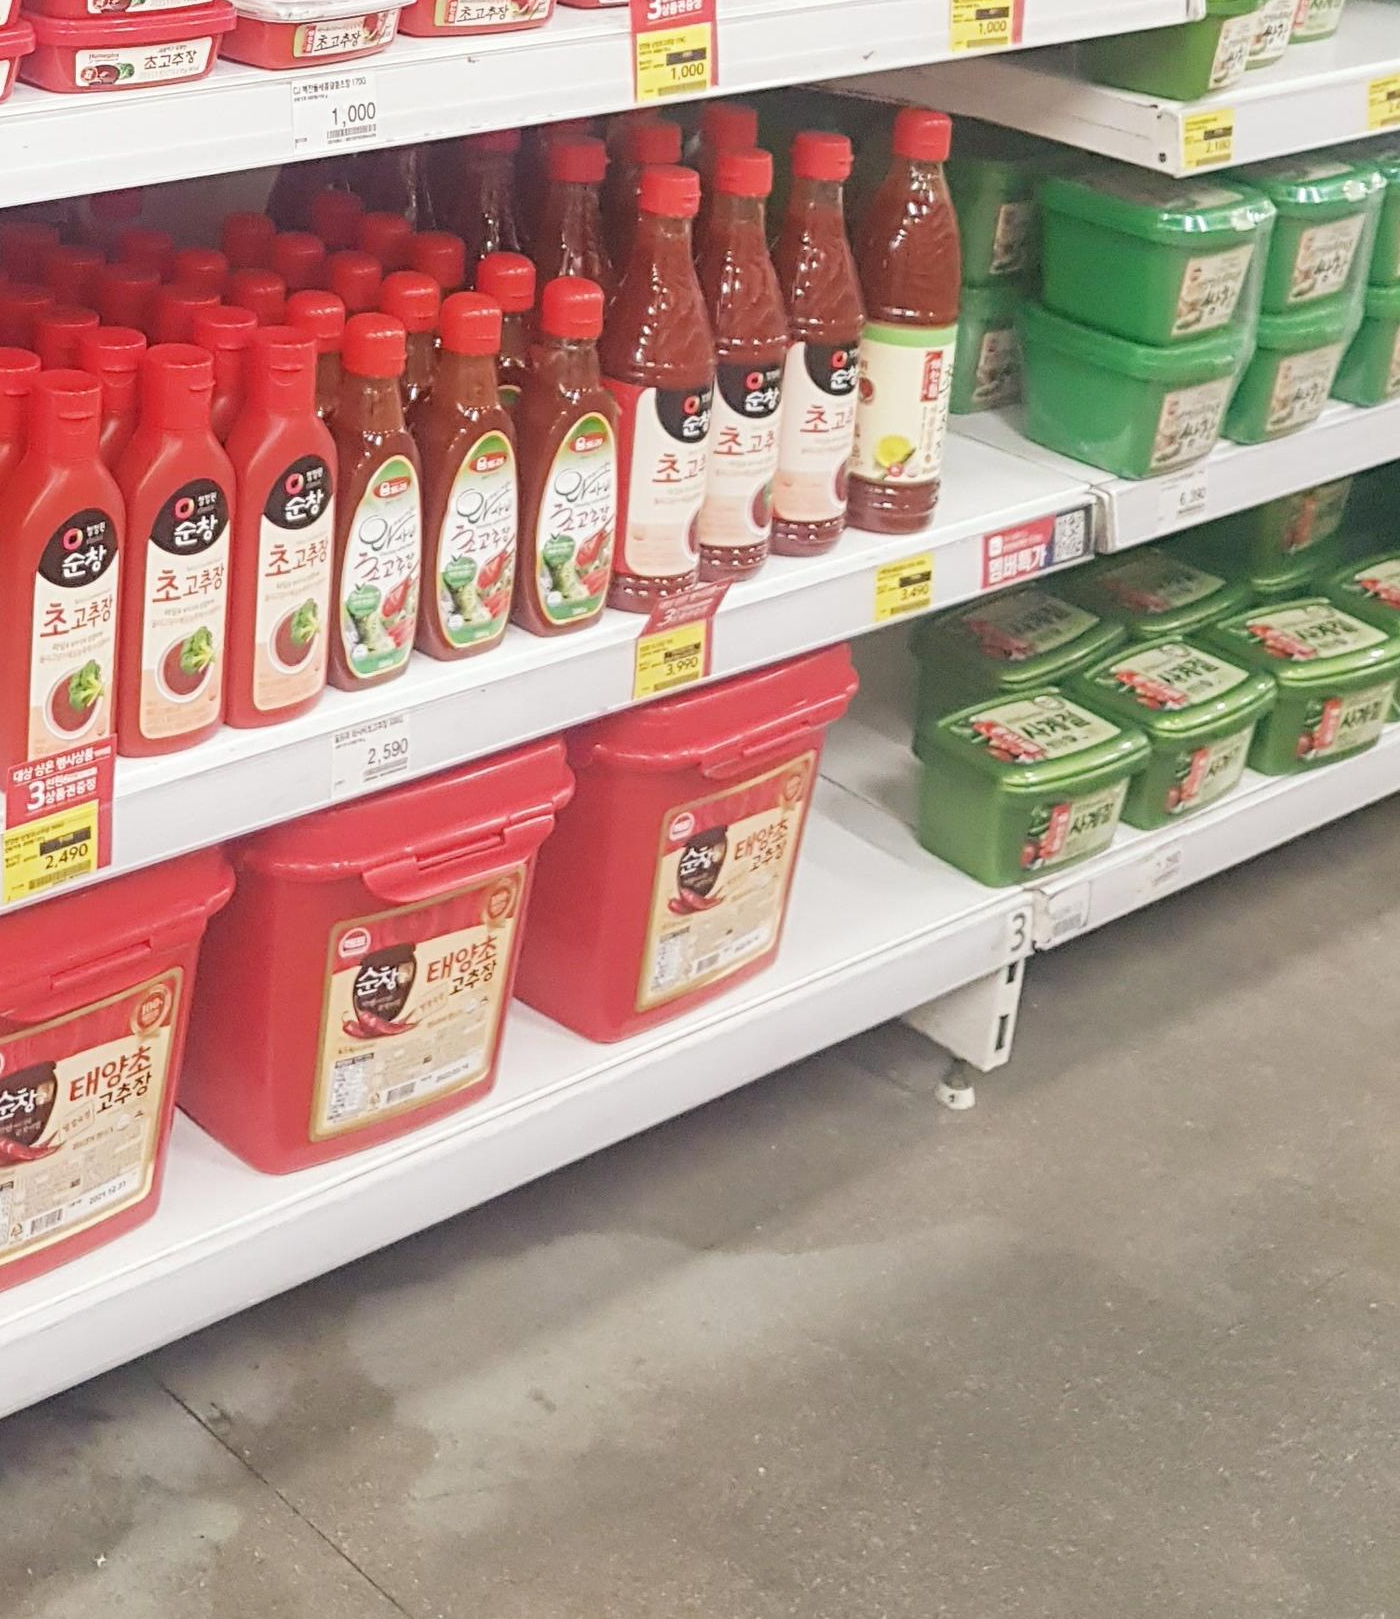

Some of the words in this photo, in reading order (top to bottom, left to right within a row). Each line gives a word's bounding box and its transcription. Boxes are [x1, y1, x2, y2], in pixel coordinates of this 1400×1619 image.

[457, 3, 510, 22] 초고추장
[977, 19, 1008, 35] 1,000
[314, 30, 363, 53] 초고추장
[671, 62, 704, 80] 1,000
[332, 102, 376, 127] 1,000
[744, 389, 781, 416] 순창
[988, 540, 1047, 577] 멤버특가
[900, 583, 931, 602] 3,490
[664, 656, 700, 676] 3,990
[367, 738, 409, 767] 2,590
[26, 780, 46, 811] 3
[733, 818, 790, 863] 태양초
[45, 843, 88, 870] 2,490
[679, 838, 715, 876] 순창
[749, 840, 788, 874] 고추장
[426, 934, 498, 983] 태양초
[355, 964, 399, 998] 순창
[450, 964, 497, 998] 고추장
[69, 1046, 152, 1102] 태양초
[96, 1072, 152, 1115] 고추장
